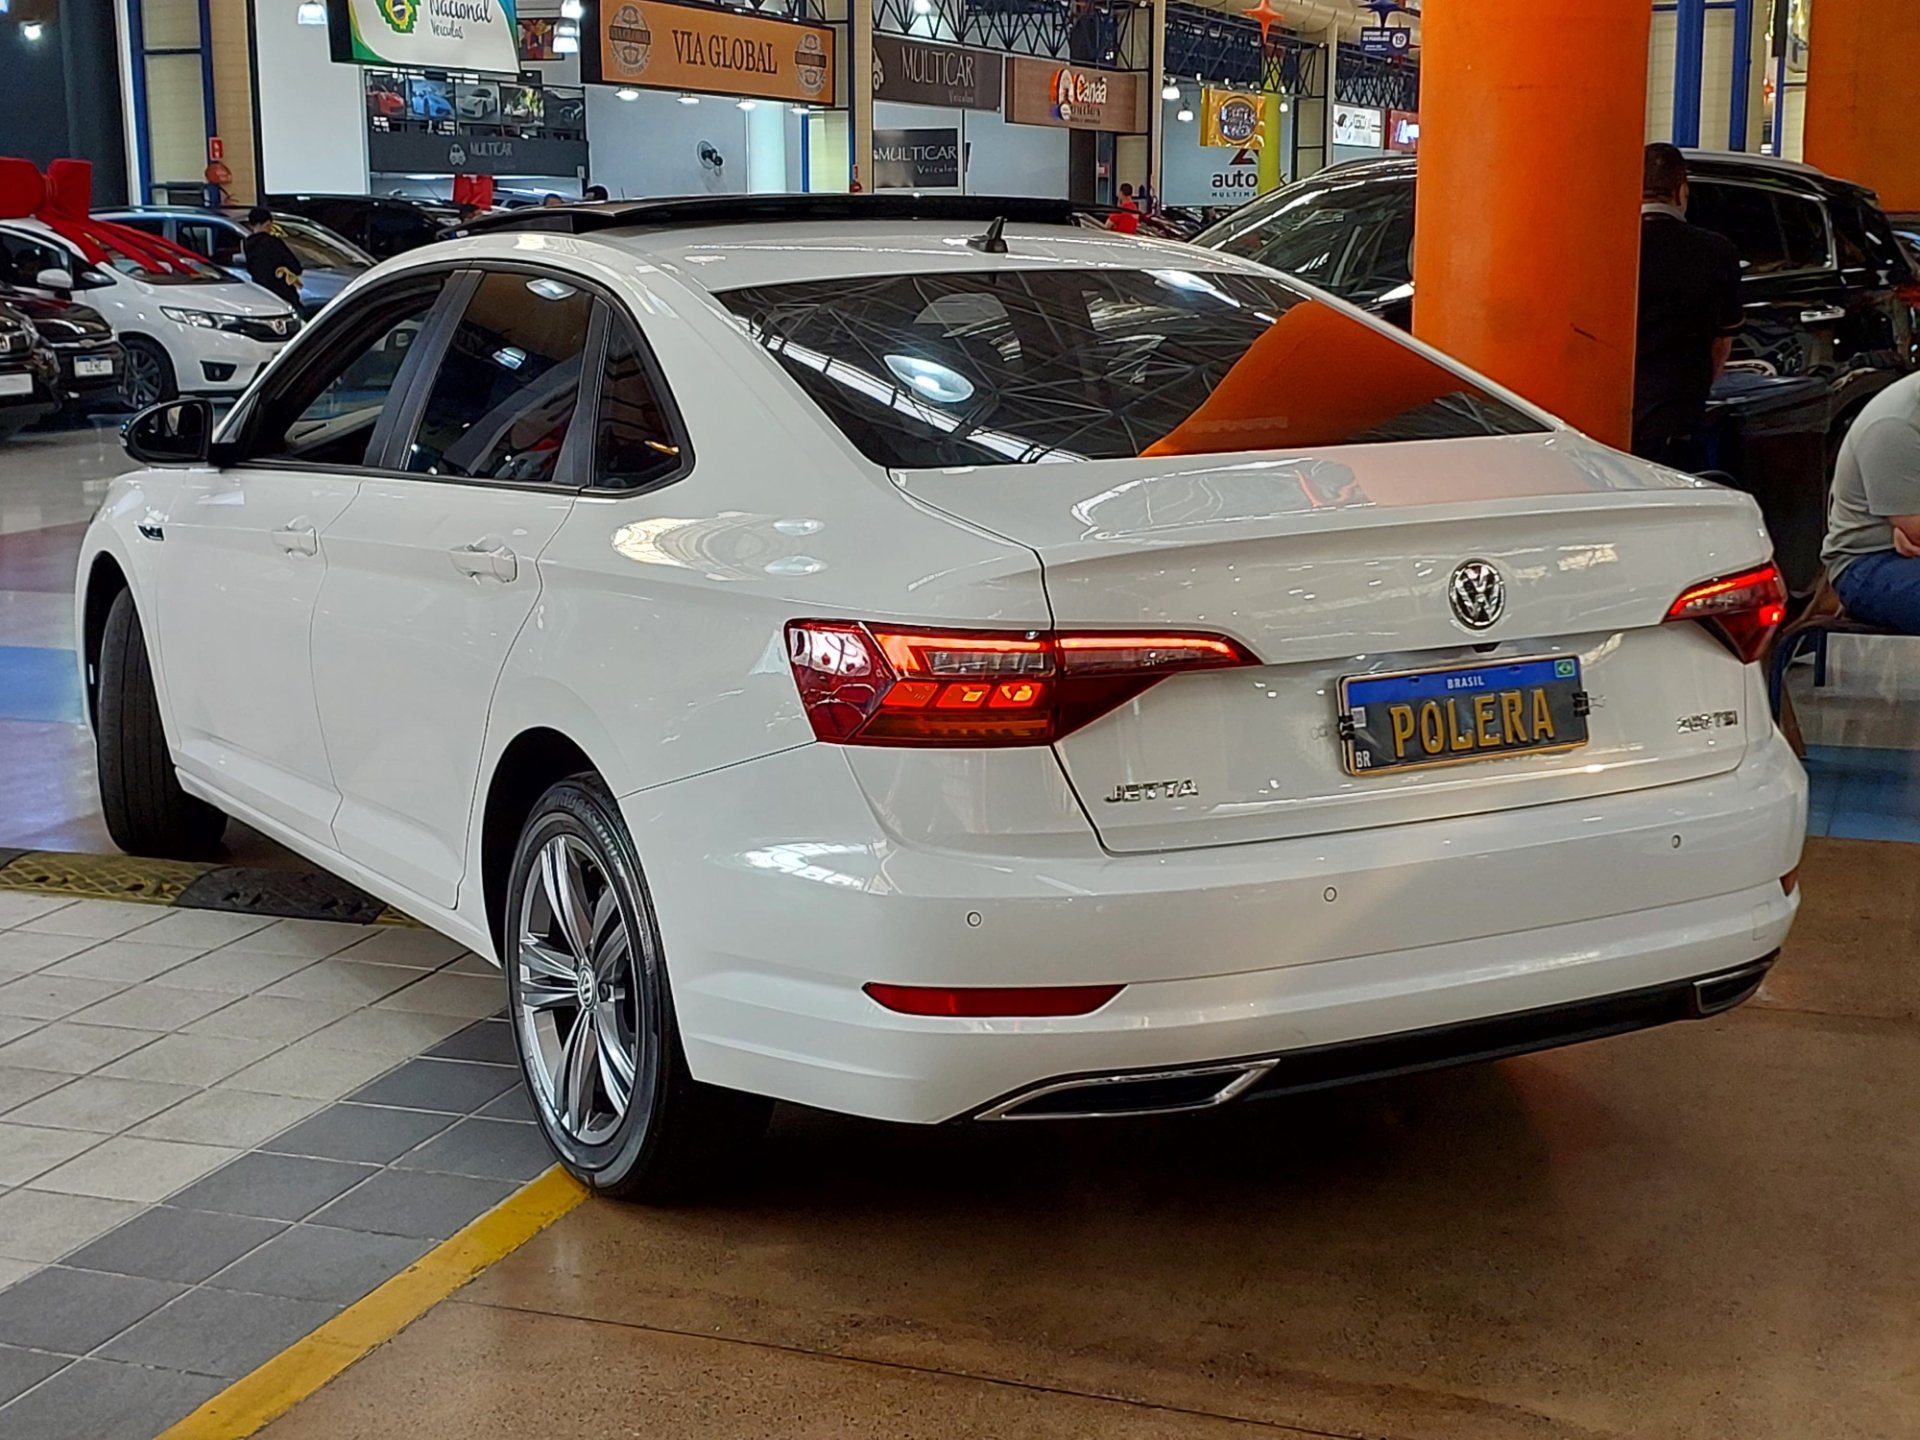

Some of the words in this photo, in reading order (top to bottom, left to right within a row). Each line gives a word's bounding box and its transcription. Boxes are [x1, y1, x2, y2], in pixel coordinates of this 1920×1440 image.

[429, 0, 493, 24] Nacional
[672, 29, 706, 66] VIA
[708, 34, 778, 75] GLOBAL
[901, 45, 975, 88] MULTICAR
[878, 145, 957, 162] MULTICAR
[1446, 675, 1485, 690] BRASIL
[1389, 687, 1555, 759] POLERA
[1355, 750, 1372, 769] BR
[1103, 777, 1200, 804] JETTA
